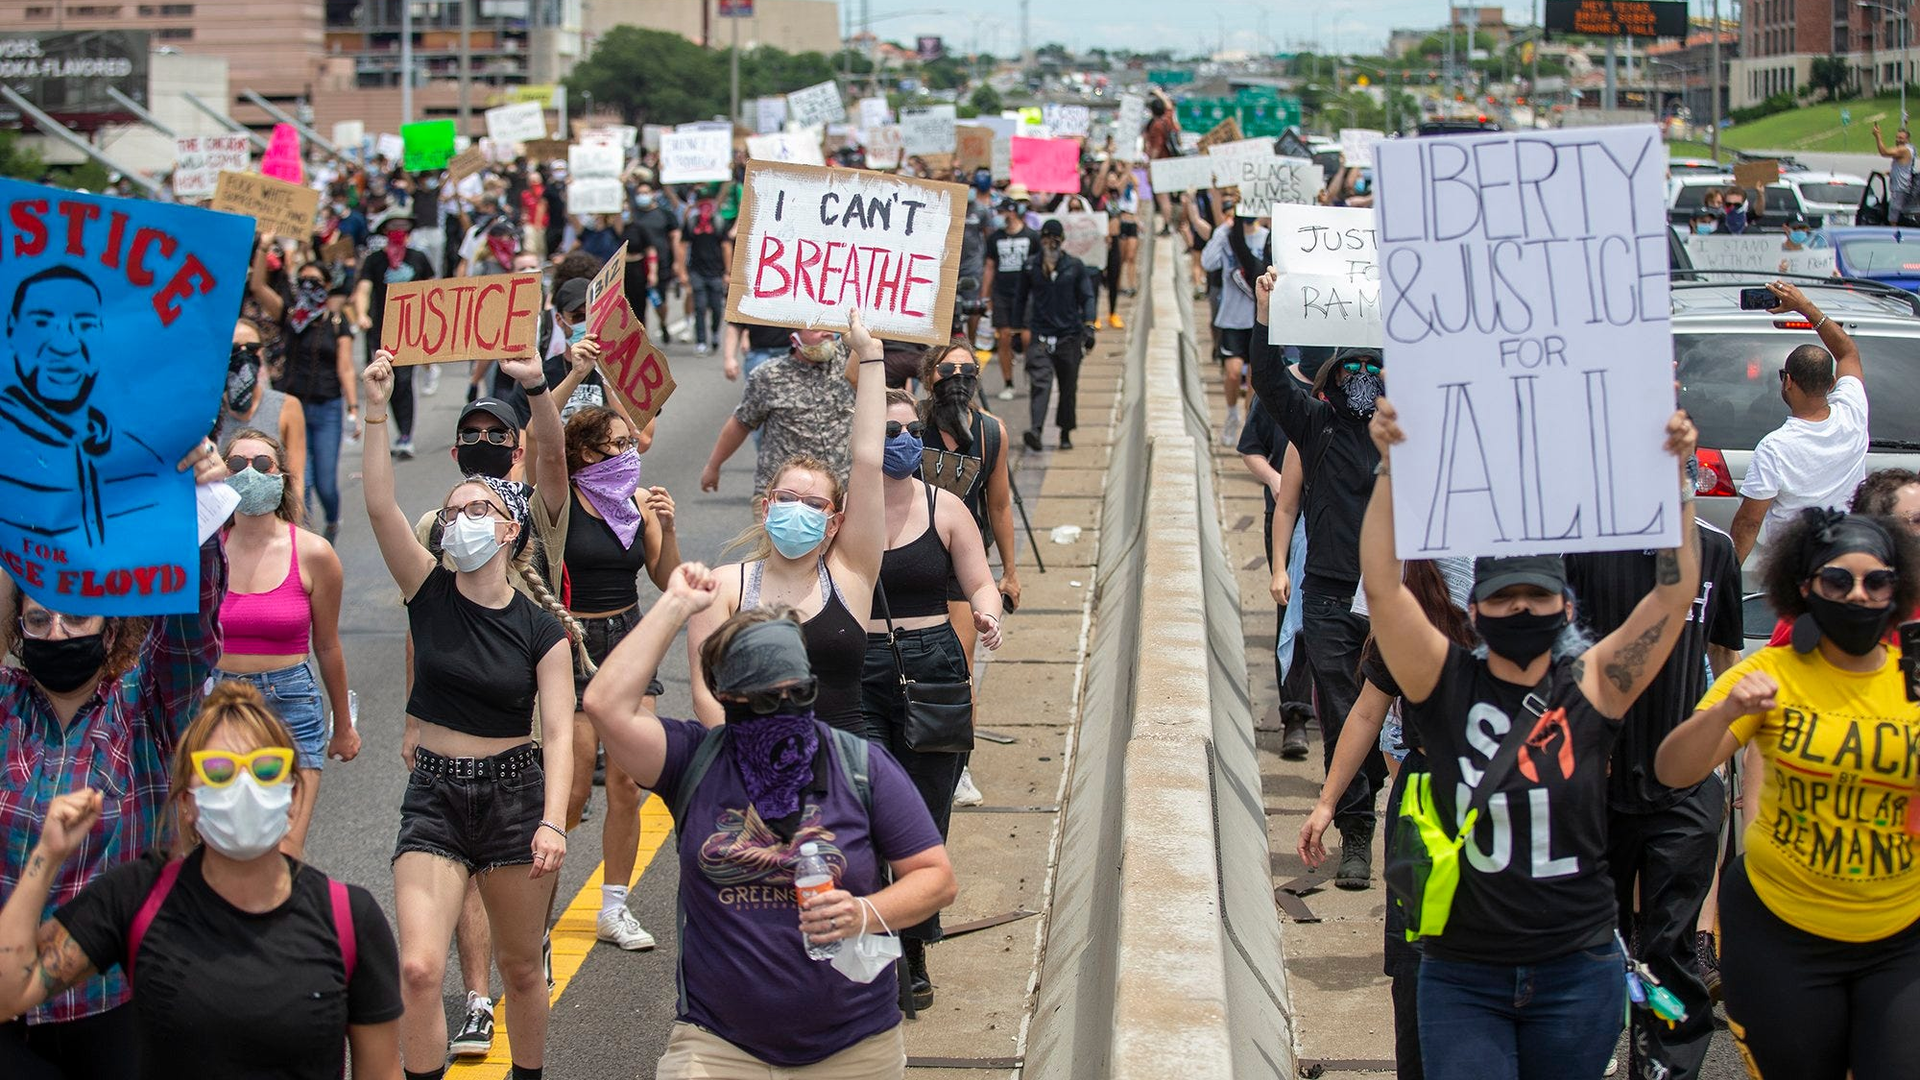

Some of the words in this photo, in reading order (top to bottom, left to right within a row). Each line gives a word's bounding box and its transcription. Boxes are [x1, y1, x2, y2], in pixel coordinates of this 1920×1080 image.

[0, 57, 132, 77] DKA-FLAVORED
[1242, 161, 1302, 182] BLACK
[1253, 181, 1302, 200] LIVES
[1376, 136, 1653, 242] LIBERTY
[776, 189, 786, 222] I
[819, 192, 926, 236] CAN'T
[0, 199, 217, 327] STICE
[1723, 240, 1769, 251] STAND
[754, 231, 937, 318] BREATHE
[384, 277, 536, 356] JUSTICE
[1499, 335, 1568, 369] FOR
[1418, 369, 1665, 551] ALL
[0, 550, 44, 588] GE
[57, 564, 187, 597] FLOYD
[23, 538, 68, 565] FOR
[1777, 706, 1920, 779] BLACK
[1775, 767, 1910, 828] POPULAR
[1838, 771, 1858, 785] BY
[1772, 806, 1913, 877] DEMAND
